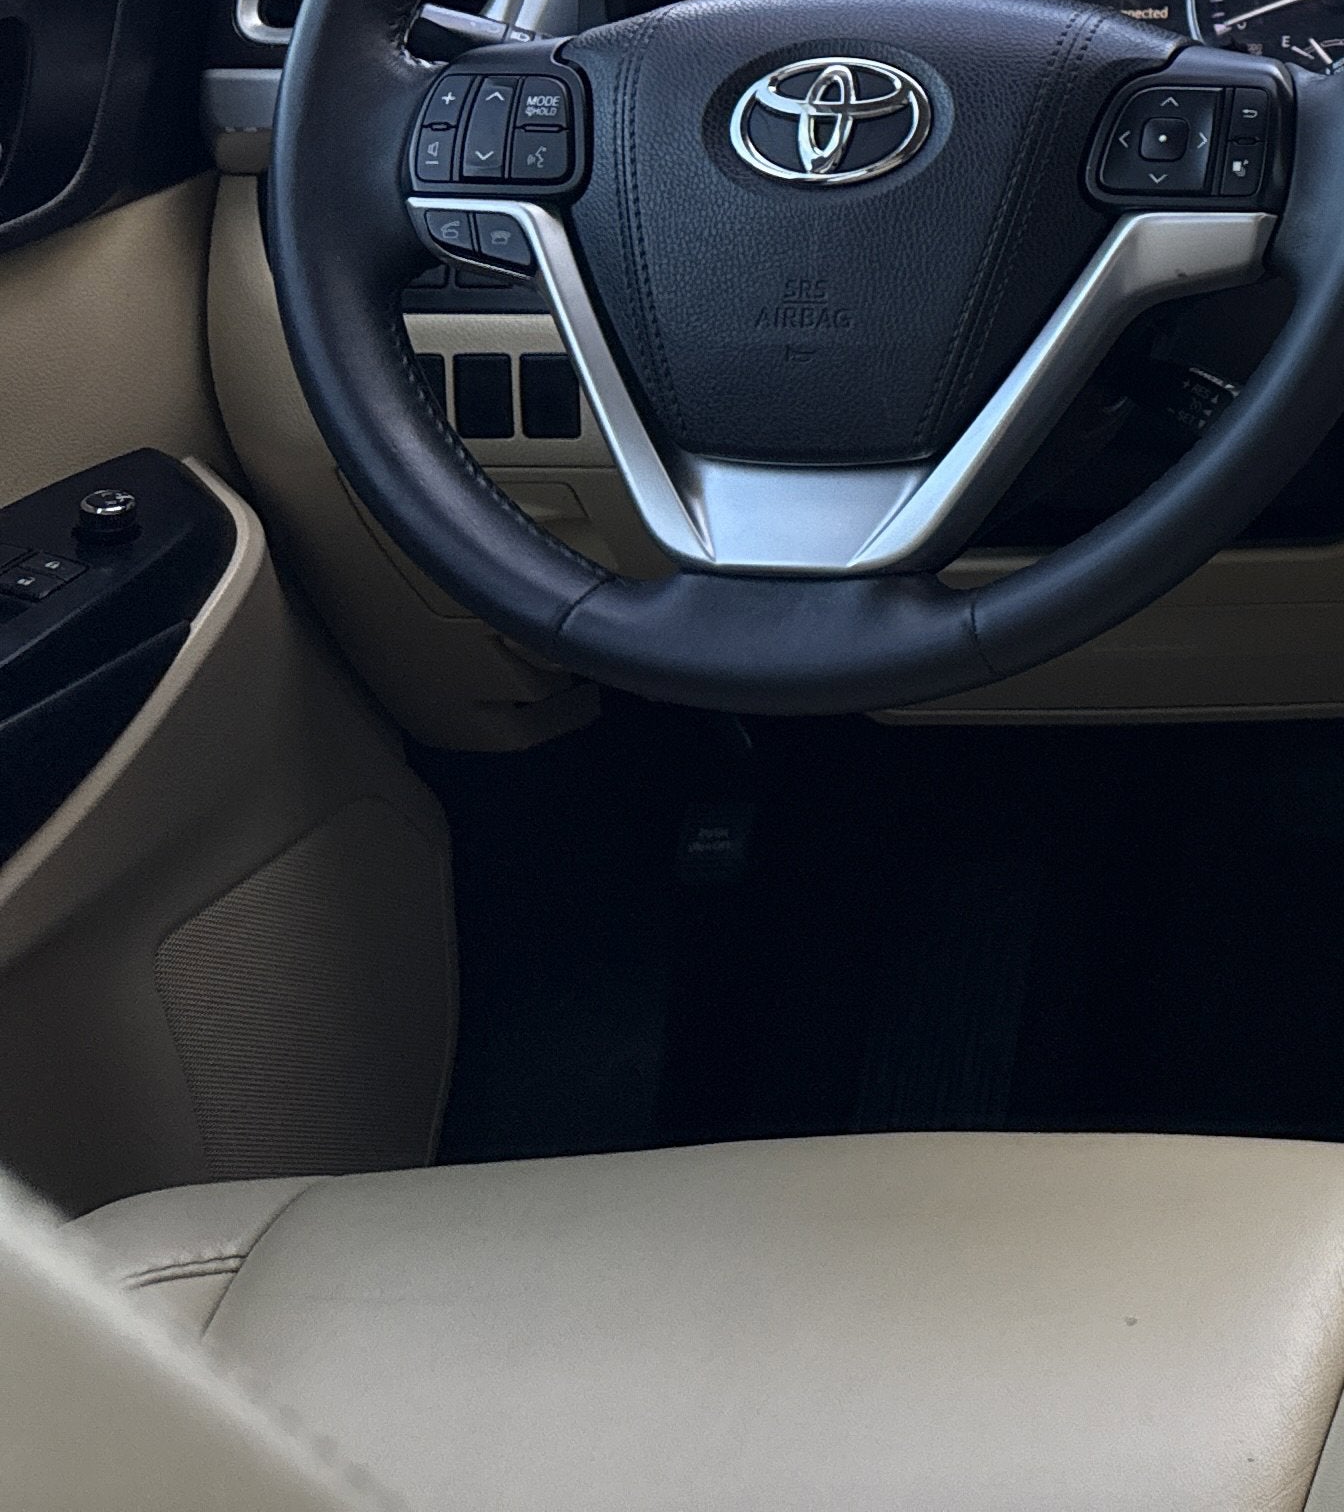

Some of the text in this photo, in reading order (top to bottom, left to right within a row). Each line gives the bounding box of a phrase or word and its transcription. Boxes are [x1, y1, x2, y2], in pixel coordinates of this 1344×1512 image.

[1281, 35, 1291, 48] E
[526, 95, 560, 107] MODE
[783, 280, 828, 299] SRS
[754, 307, 853, 328] AIRBAG
